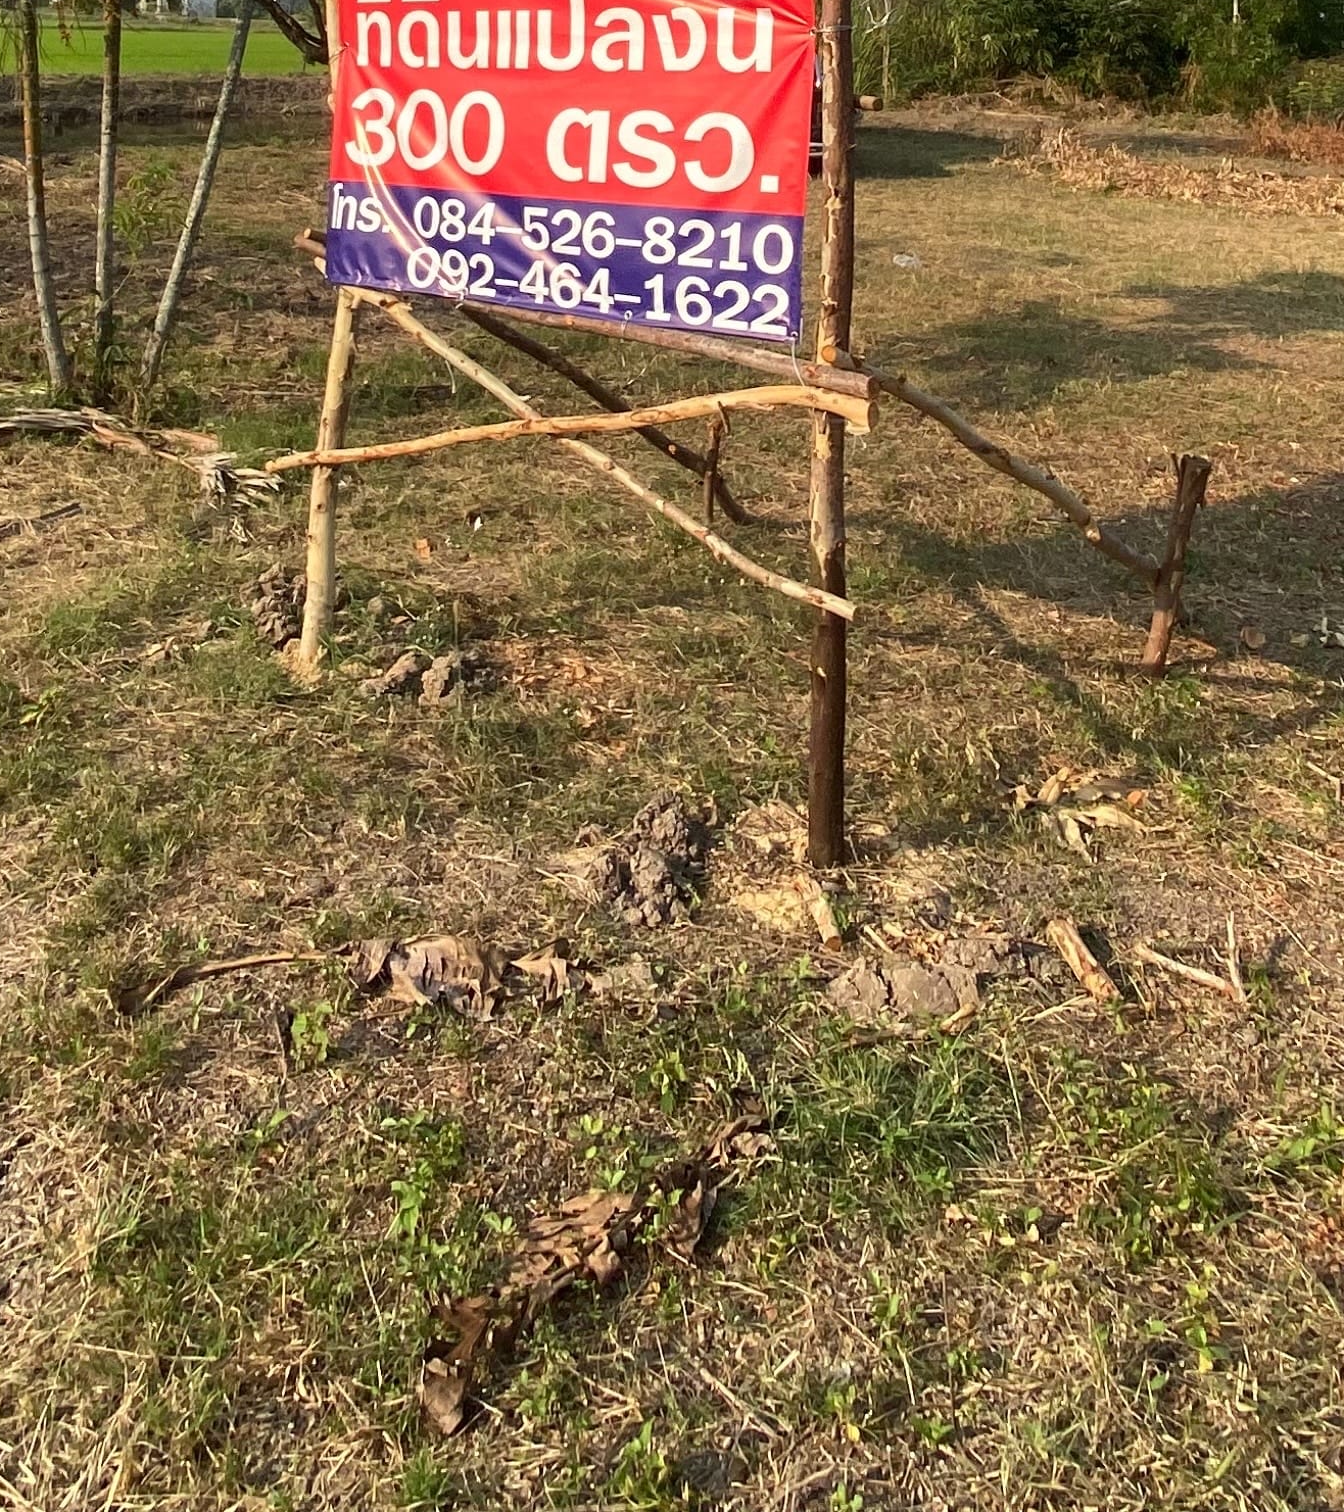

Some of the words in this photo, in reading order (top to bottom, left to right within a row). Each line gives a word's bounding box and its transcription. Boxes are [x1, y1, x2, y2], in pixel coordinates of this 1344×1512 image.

[346, 88, 505, 172] 300
[546, 108, 779, 193] ตรว.
[413, 195, 794, 275] 084-526-8210
[407, 246, 788, 334] 092-464-1622
